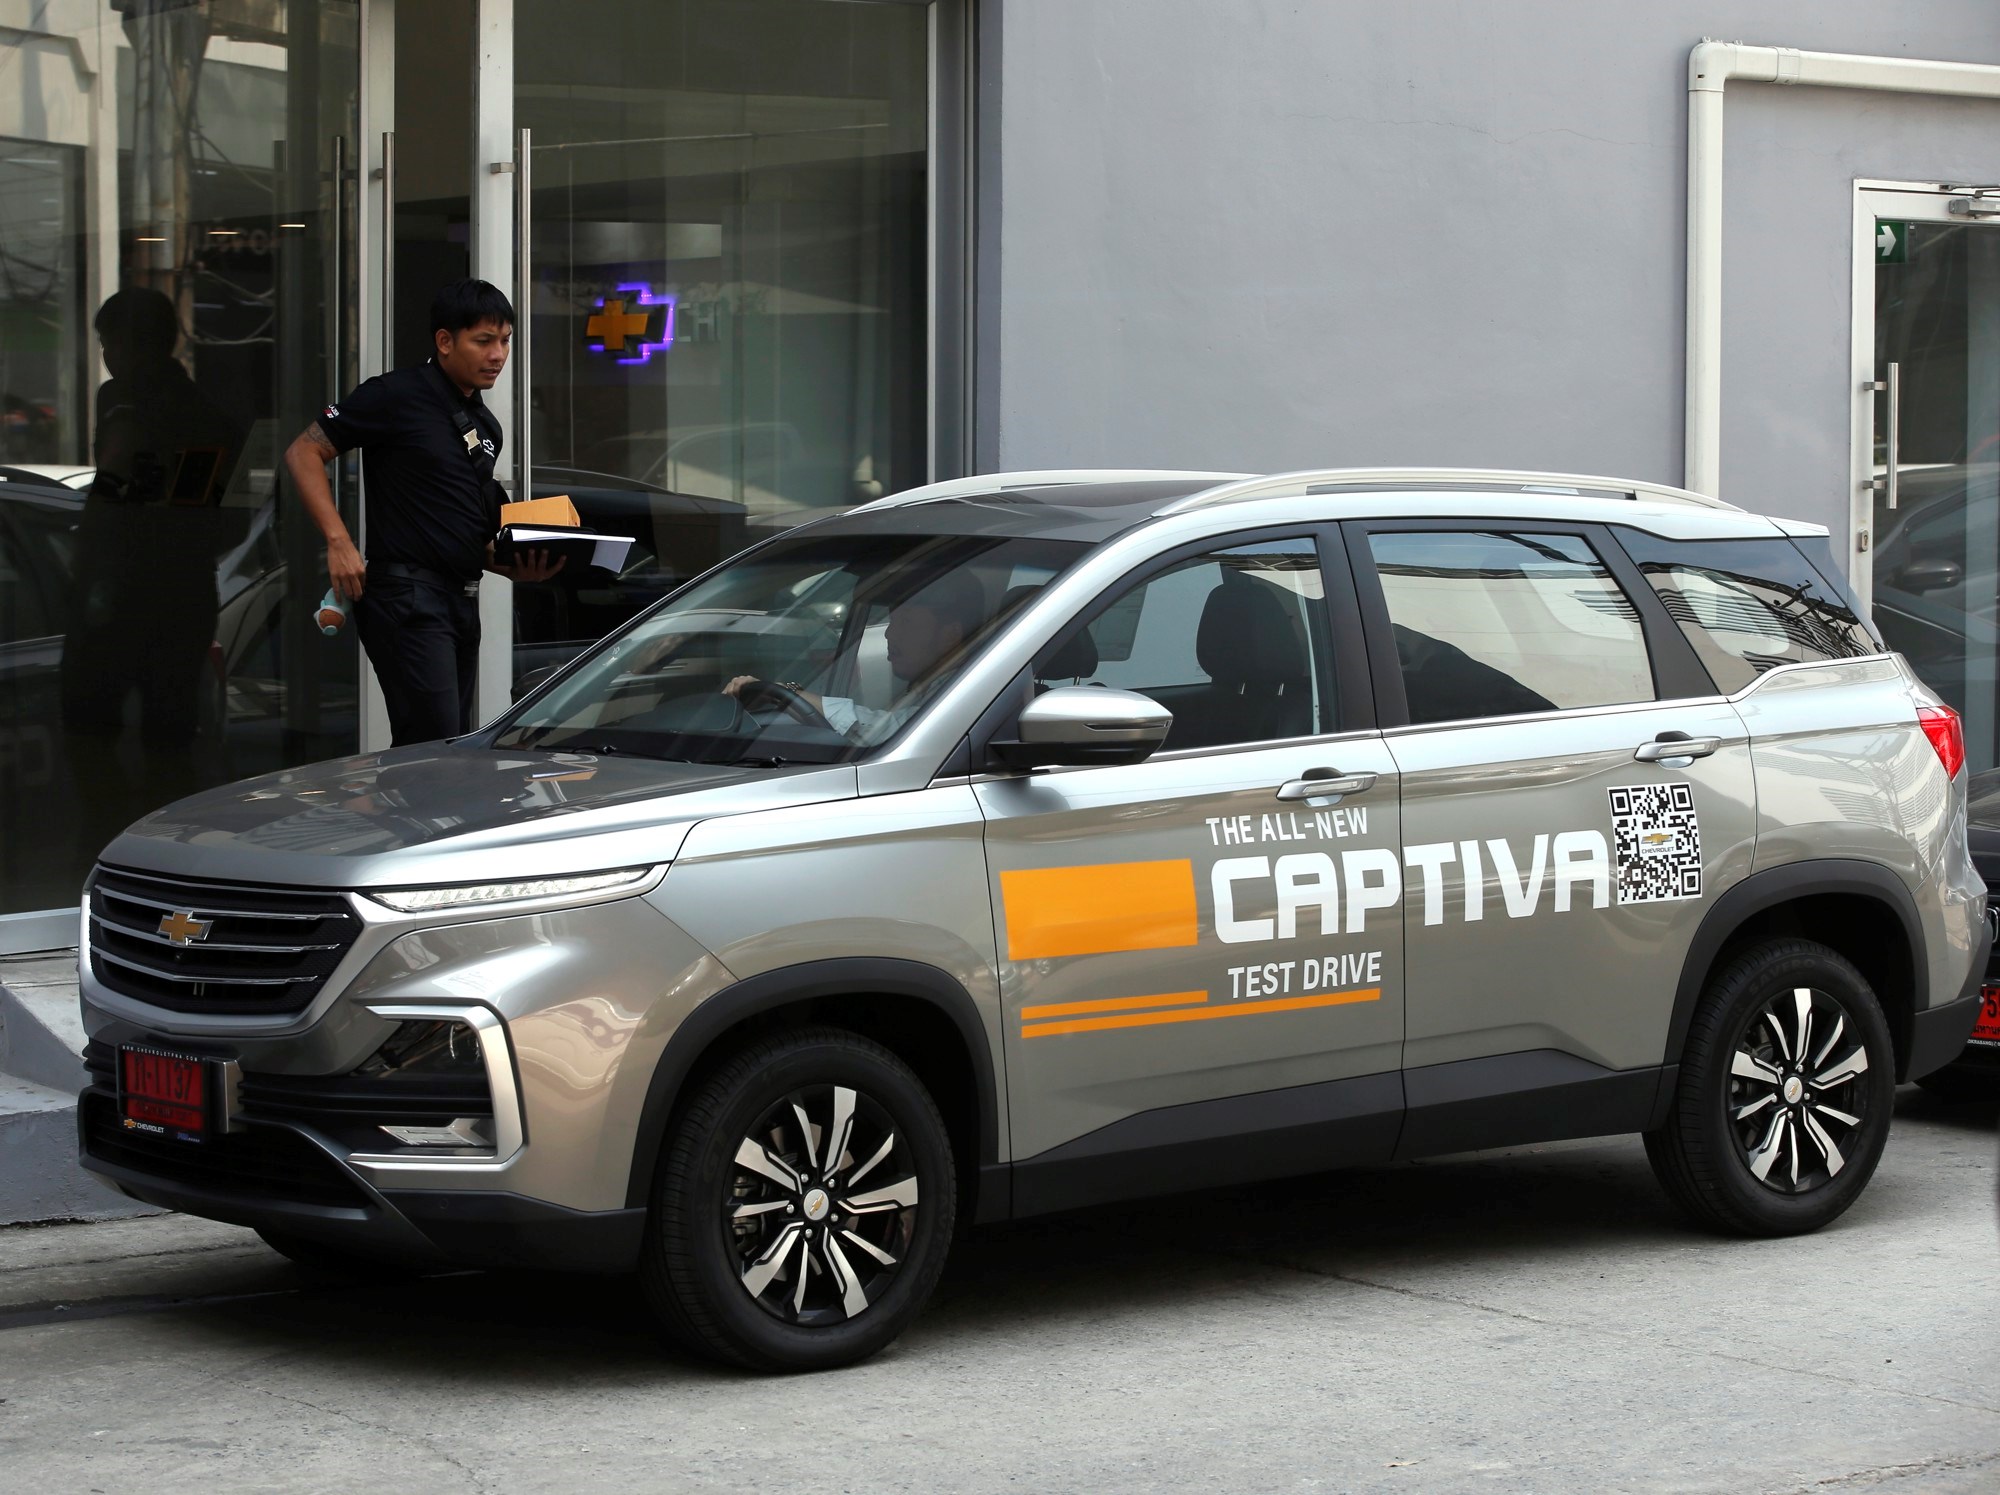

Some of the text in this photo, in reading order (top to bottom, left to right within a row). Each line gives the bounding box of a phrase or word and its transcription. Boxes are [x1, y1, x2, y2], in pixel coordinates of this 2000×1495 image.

[1205, 806, 1368, 846] THE ALL-NEW
[1641, 846, 1675, 855] CHEVROLET
[1210, 829, 1610, 944] CAPTIVA
[1227, 951, 1382, 999] TEST DRIVE
[137, 1123, 164, 1133] CHEVROLET
